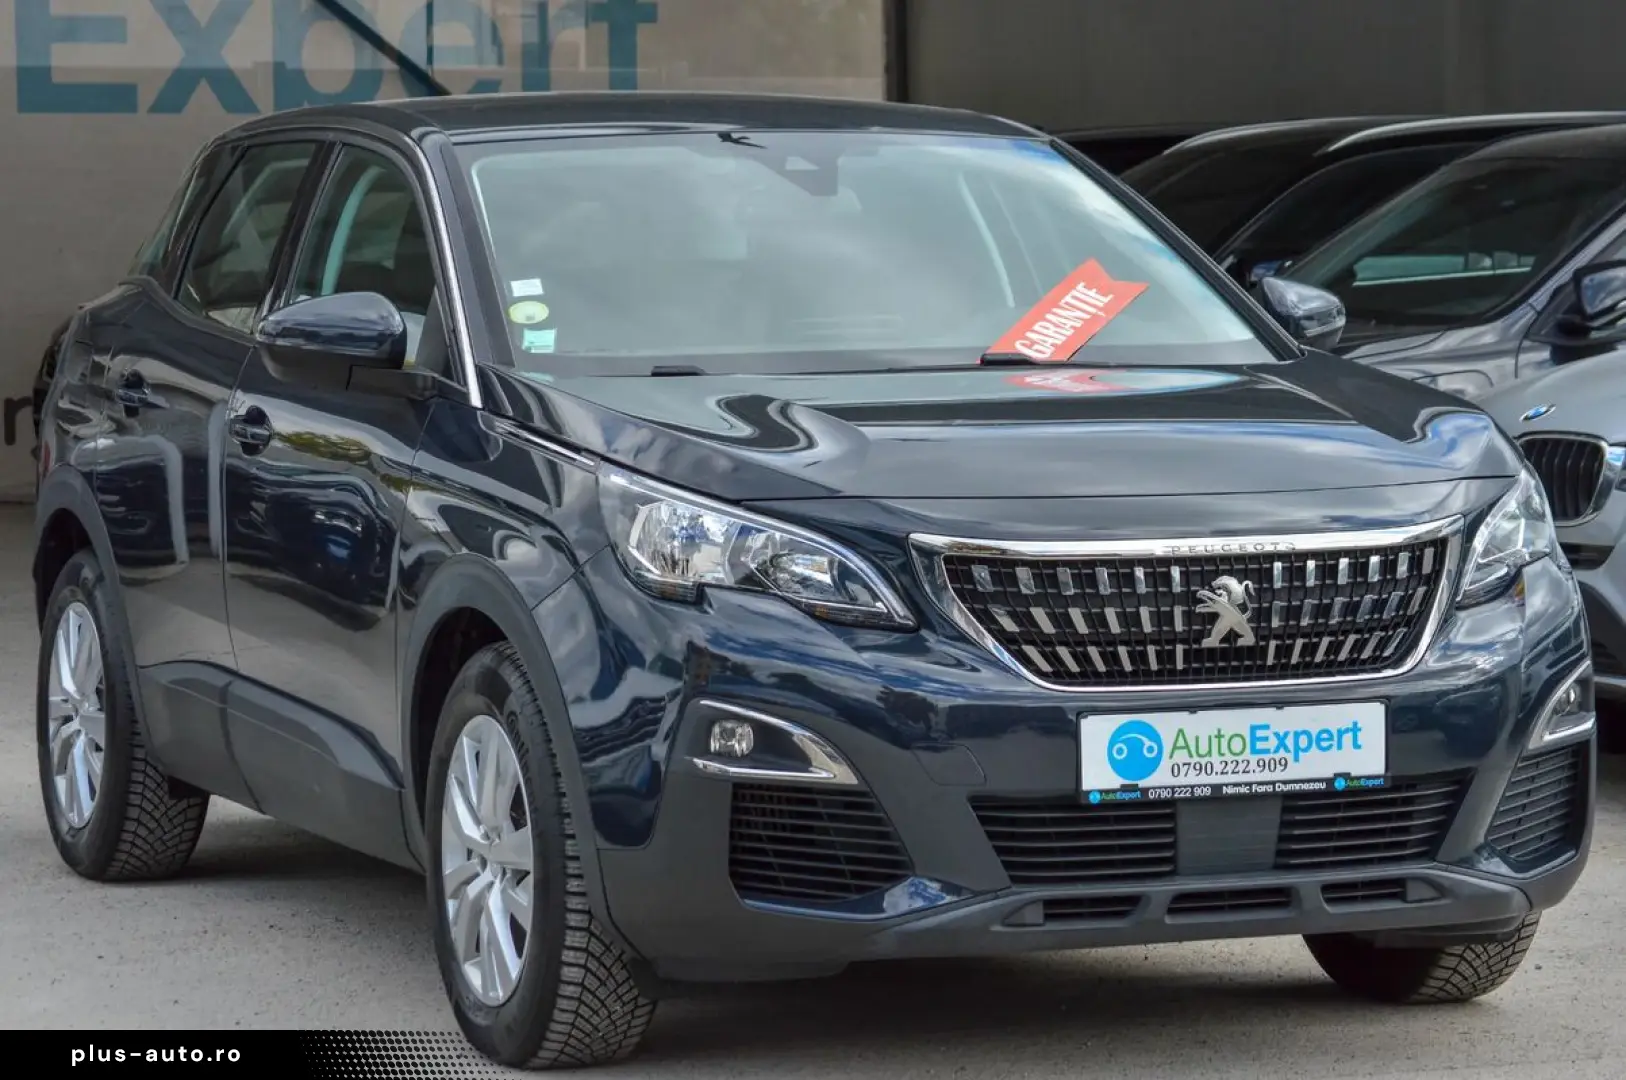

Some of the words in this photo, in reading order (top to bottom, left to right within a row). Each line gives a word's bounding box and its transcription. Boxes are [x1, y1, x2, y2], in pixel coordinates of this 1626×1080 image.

[1170, 541, 1281, 554] PEUGEOT
[1169, 720, 1363, 763] AutoExpert
[1171, 757, 1289, 778] 0790.222.909
[1101, 790, 1141, 800] AutoExpert
[1148, 788, 1172, 799] 0790
[1174, 787, 1191, 797] 222
[1193, 786, 1211, 796] 909
[1222, 783, 1250, 794] Nimic
[1252, 783, 1273, 793] Fara
[1275, 781, 1326, 792] Dumnezeu
[1345, 778, 1384, 788] AutoExpert
